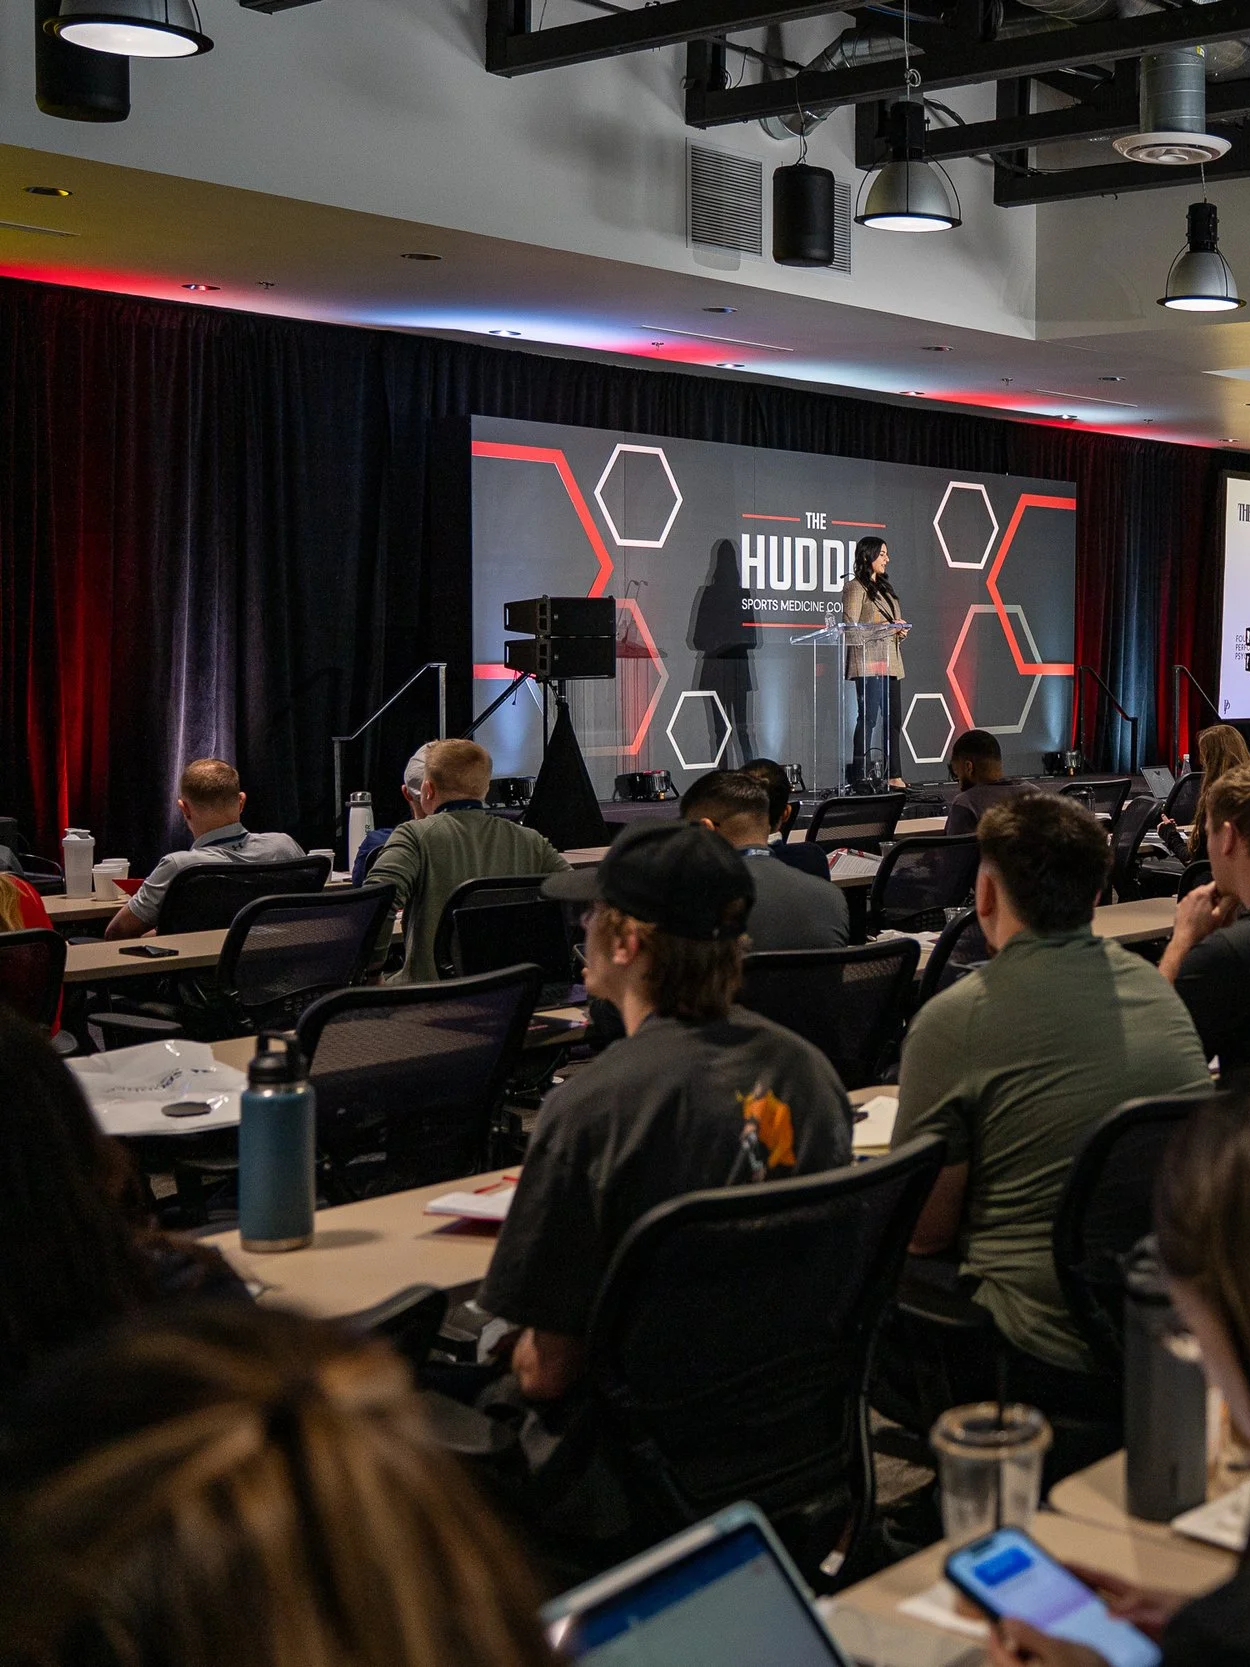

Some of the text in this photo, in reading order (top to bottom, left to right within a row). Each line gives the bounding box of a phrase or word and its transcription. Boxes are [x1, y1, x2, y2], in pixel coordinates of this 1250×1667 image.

[805, 511, 827, 530] THE
[741, 598, 779, 611] SPORTS
[780, 600, 825, 613] MEDICINE
